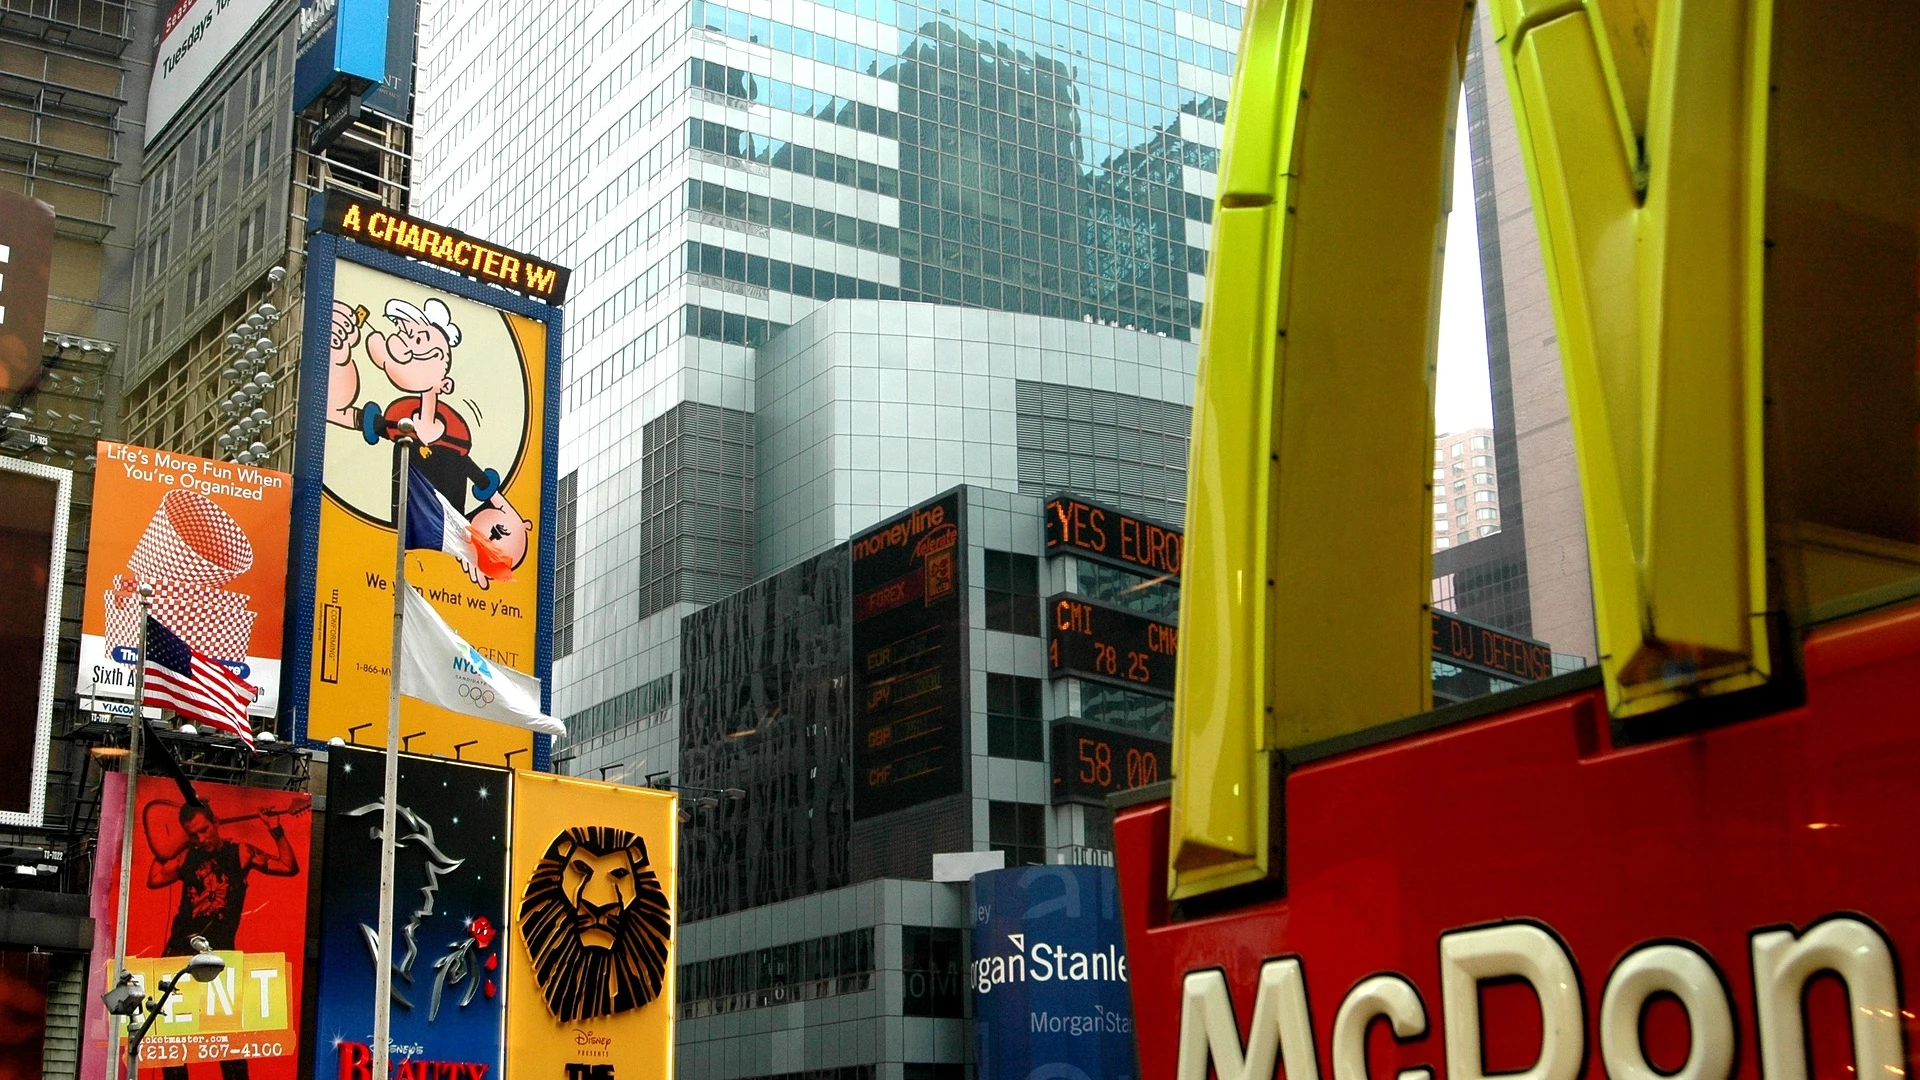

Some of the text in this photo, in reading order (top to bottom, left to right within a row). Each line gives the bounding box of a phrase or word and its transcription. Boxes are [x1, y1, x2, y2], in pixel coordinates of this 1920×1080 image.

[162, 9, 213, 79] Tuesdays
[342, 204, 361, 232] A
[367, 212, 521, 283] CHARACTER
[106, 444, 283, 488] Life's More Fun When
[123, 463, 263, 501] You're Organized
[852, 505, 945, 562] moneyline
[1121, 517, 1185, 574] EURO
[365, 571, 387, 591] We
[428, 588, 462, 606] what
[466, 596, 487, 611] we
[868, 580, 905, 611] FOREX
[1057, 600, 1093, 636] CMI
[1094, 641, 1151, 683] 78.25
[1451, 620, 1474, 660] DJ
[1482, 630, 1552, 681] DEFENSE
[92, 665, 123, 687] Sixth
[867, 687, 892, 710] JPY
[867, 725, 893, 749] GBP
[867, 764, 893, 787] CHF
[1079, 738, 1158, 789] 58.00
[1177, 918, 1903, 1080] McDon
[1031, 1011, 1104, 1036] Morgan
[137, 1042, 283, 1062] (212) 307-4100
[577, 1050, 610, 1058] PRESENTS
